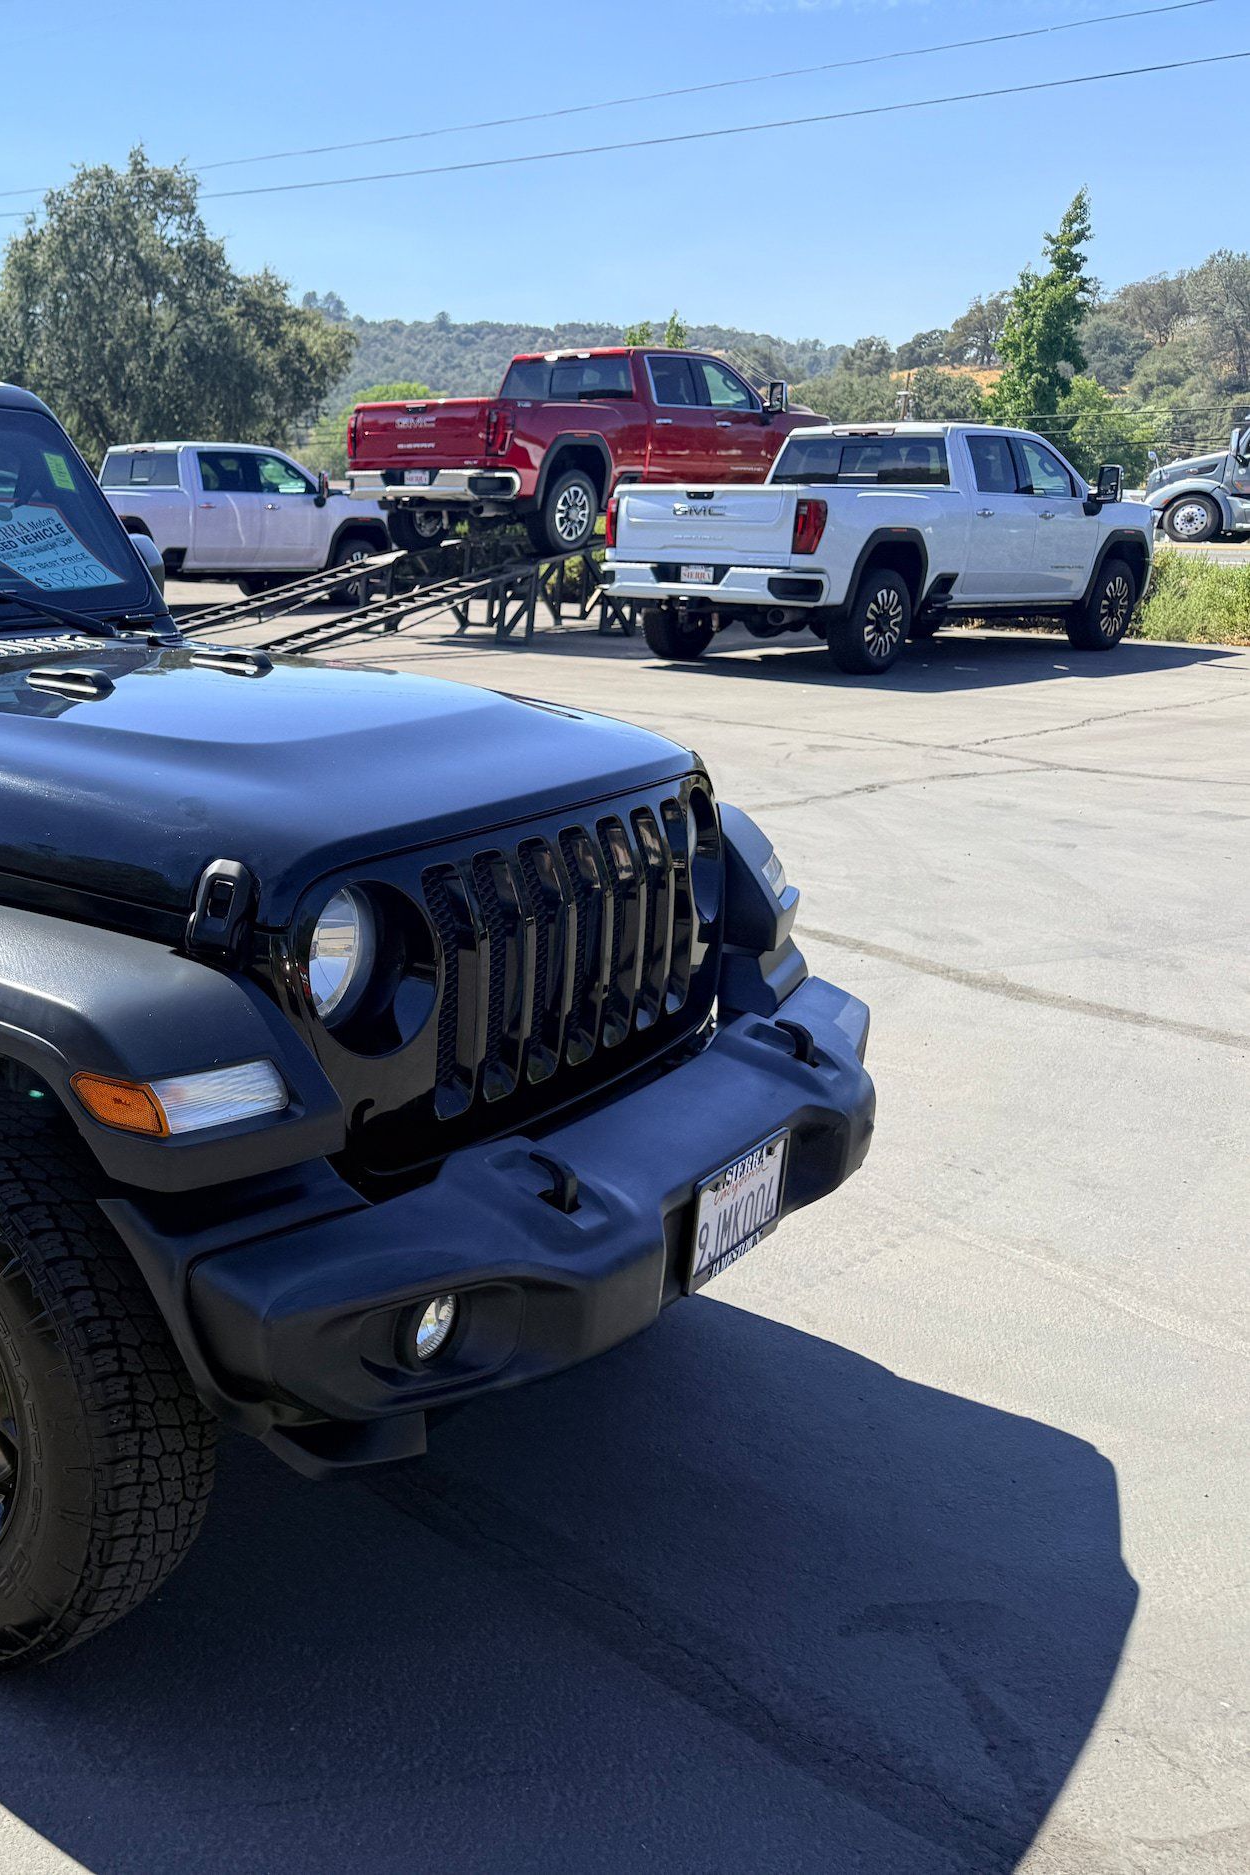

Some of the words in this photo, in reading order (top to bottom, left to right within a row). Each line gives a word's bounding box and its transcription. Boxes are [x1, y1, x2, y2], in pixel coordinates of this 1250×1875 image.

[673, 503, 726, 516] GMC
[16, 522, 66, 546] VEHICLE
[29, 516, 55, 531] Motors
[724, 1145, 767, 1187] SIERRA
[698, 1176, 775, 1273] 9JMK004
